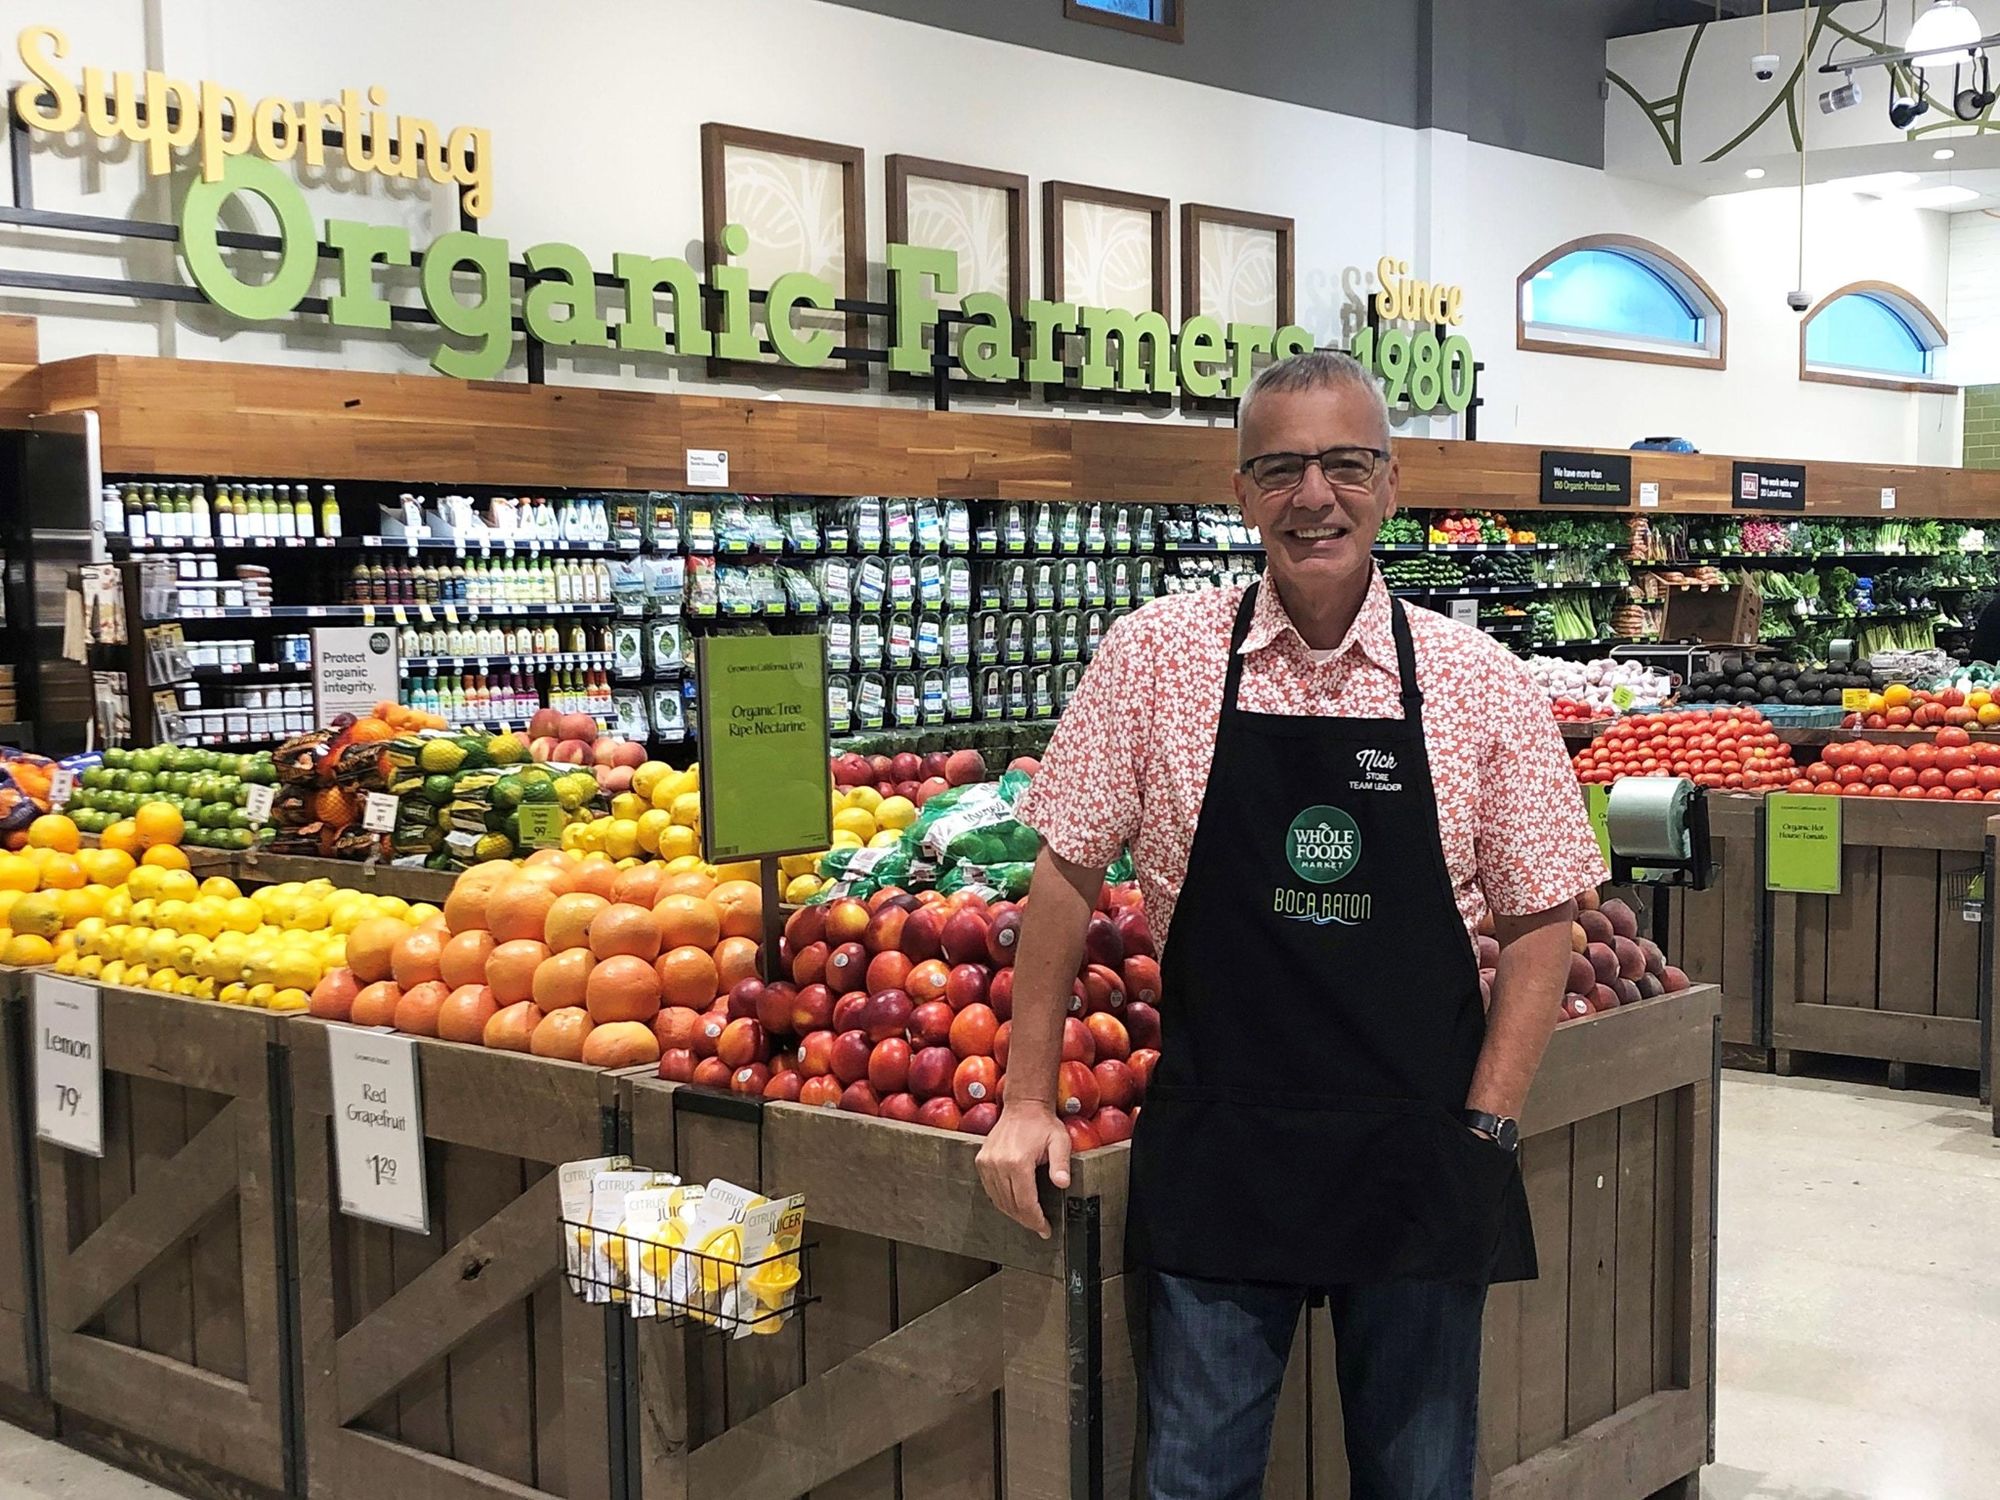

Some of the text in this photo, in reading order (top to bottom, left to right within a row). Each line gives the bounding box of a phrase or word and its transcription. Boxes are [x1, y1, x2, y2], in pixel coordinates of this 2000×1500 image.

[15, 24, 493, 219] Supporting
[180, 154, 839, 380] Organic
[1376, 255, 1464, 327] Since
[1351, 326, 1475, 413] 1980
[1553, 467, 1603, 479] We have more than
[1563, 480, 1584, 492] Organic
[322, 651, 367, 663] Protect
[323, 666, 369, 681] organic
[324, 680, 377, 695] integrity.
[731, 702, 802, 722] Organic Tree
[729, 721, 807, 738] Ripe Nectarine
[1355, 749, 1398, 771] Nick
[1365, 771, 1390, 782] STORE
[1348, 780, 1403, 792] TEAM LEADER
[1778, 832, 1828, 840] House Tomato
[1782, 823, 1825, 832] Organic Hot
[1294, 828, 1354, 845] WHOLE
[1295, 844, 1353, 860] FOODS
[1301, 861, 1344, 870] MARKET
[1274, 887, 1372, 920] BOCA RATON
[44, 1027, 92, 1060] Lemon
[363, 1082, 388, 1104] Red
[346, 1102, 407, 1132] Grapefruit
[597, 1179, 636, 1192] CITRUS
[629, 1198, 667, 1211] CITRUS
[709, 1187, 748, 1208] CITRUS
[749, 1209, 778, 1228] CITRUS
[767, 1211, 802, 1237] JUICER
